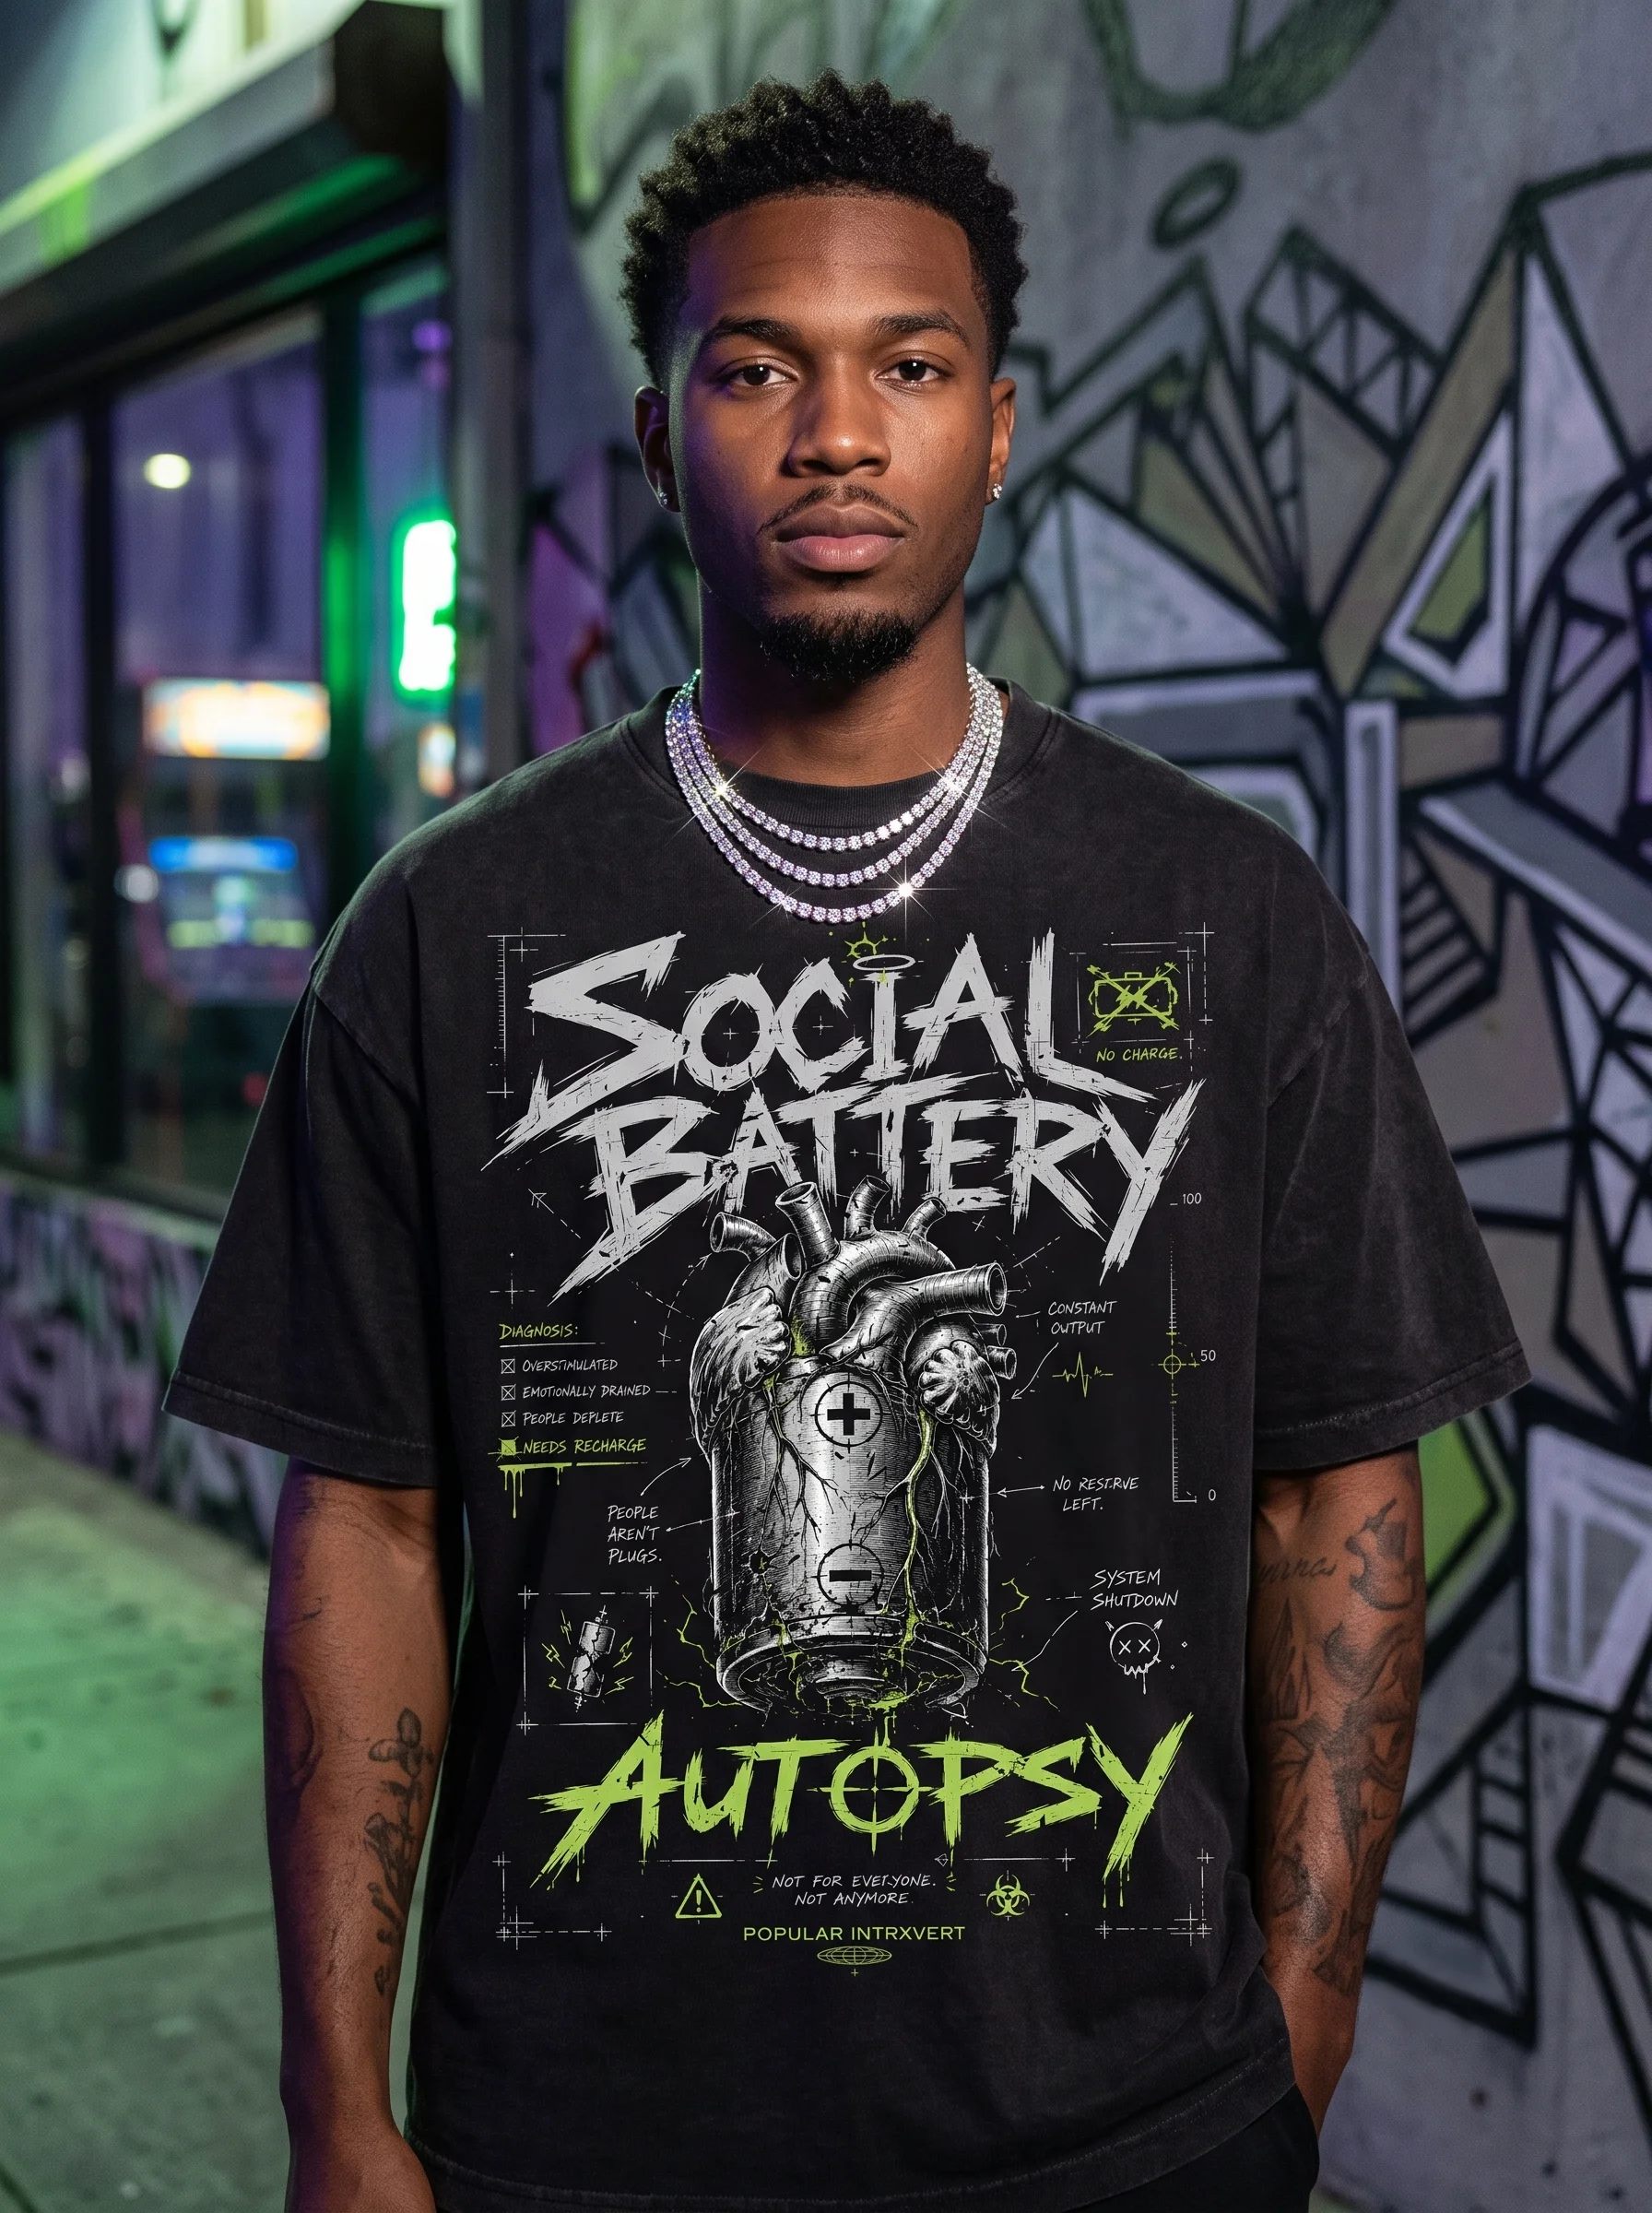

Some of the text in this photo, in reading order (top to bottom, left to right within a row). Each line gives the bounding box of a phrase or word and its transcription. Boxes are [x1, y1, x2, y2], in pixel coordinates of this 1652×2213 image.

[481, 927, 1162, 1172] SOCIAL
[1095, 1047, 1183, 1063] NO CHARGE.
[540, 1076, 1207, 1308] BATTERY
[1182, 1191, 1202, 1205] 100
[1047, 1300, 1118, 1316] CONSTANT
[498, 1321, 578, 1340] DIAGNOSIS:
[1050, 1320, 1106, 1335] OUTPUT
[1200, 1349, 1217, 1362] 50
[522, 1358, 619, 1372] OVERSTIMULATED
[522, 1383, 651, 1399] EMOTIONALLY DRAINED
[522, 1411, 624, 1426] PEOPLE DEPLETE
[523, 1438, 647, 1454] NEEDS RECHARGE
[1052, 1474, 1071, 1492] NO
[1208, 1488, 1217, 1502] 0
[1062, 1497, 1103, 1512] LEFT.
[607, 1504, 659, 1523] PEOPLE
[607, 1525, 661, 1543] AREN'T
[608, 1547, 663, 1566] PLUGS.
[1089, 1568, 1161, 1590] SYSTEM
[1090, 1589, 1179, 1611] SHUTDOWN
[772, 1874, 806, 1888] NOT
[812, 1875, 844, 1888] FOR
[794, 1891, 828, 1906] NOT
[743, 1925, 966, 1942] POPULAR INTRXVERT
